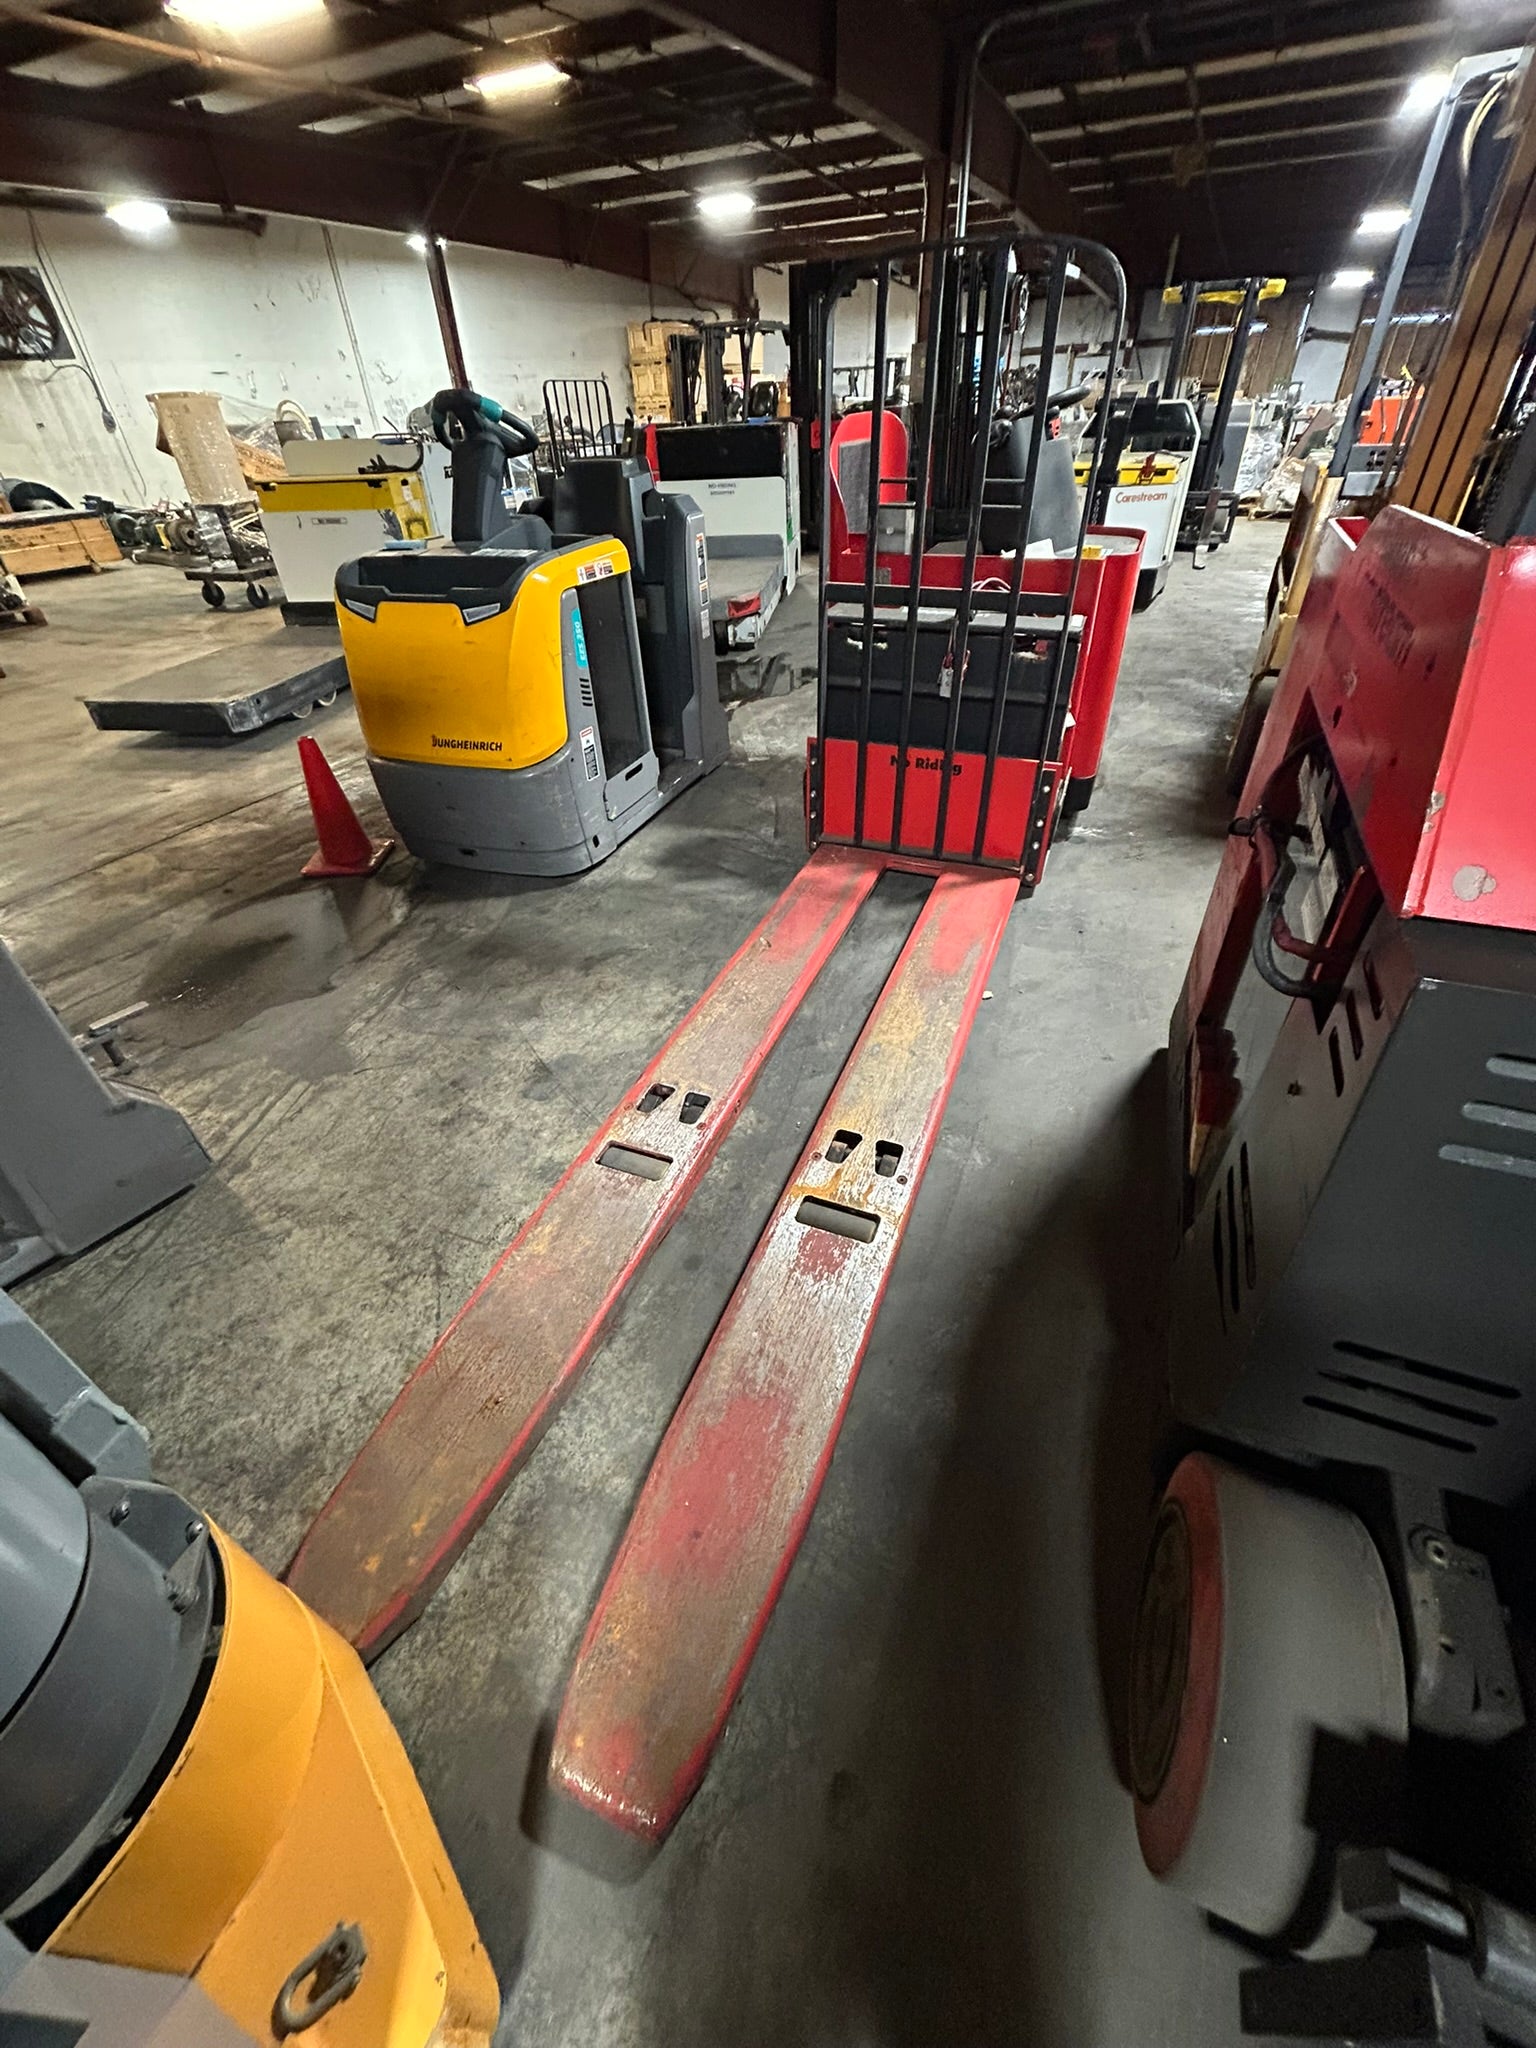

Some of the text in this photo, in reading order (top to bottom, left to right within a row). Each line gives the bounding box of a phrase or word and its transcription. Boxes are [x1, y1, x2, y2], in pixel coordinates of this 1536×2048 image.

[1115, 491, 1168, 504] Carestream
[431, 734, 503, 752] JUNGHEINRICH
[915, 757, 962, 776] Ridig
